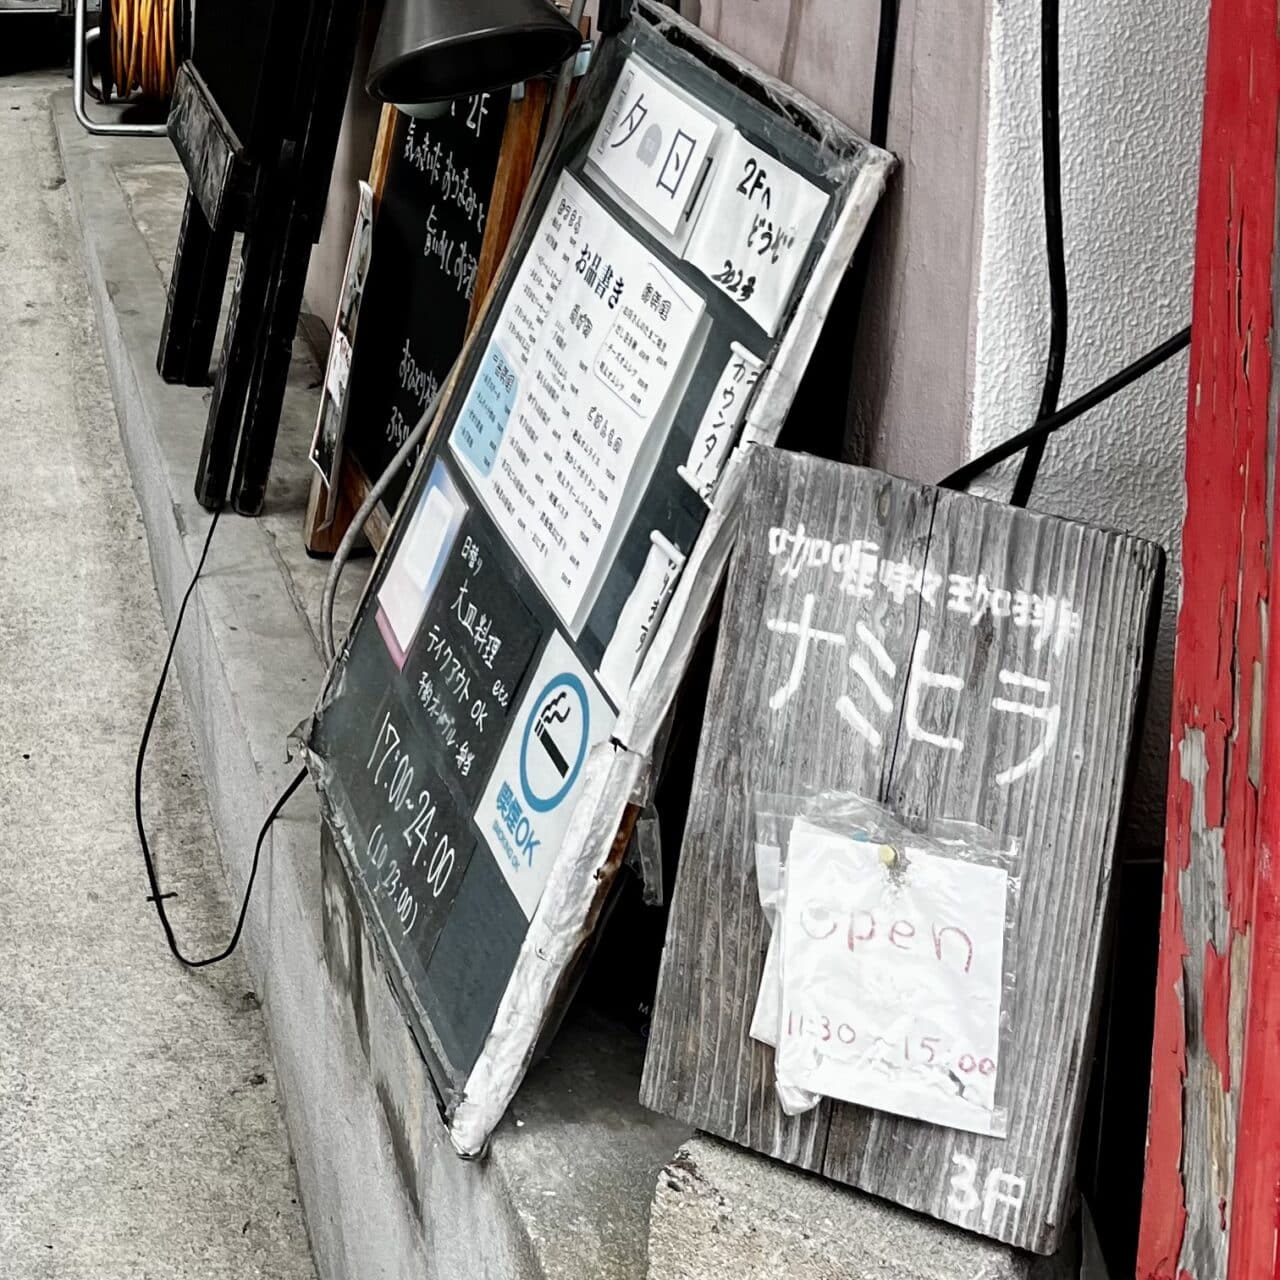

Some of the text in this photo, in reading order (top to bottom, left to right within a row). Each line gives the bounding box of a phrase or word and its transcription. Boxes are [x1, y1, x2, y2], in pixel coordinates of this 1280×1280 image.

[576, 244, 624, 309] お品書き
[748, 213, 795, 265] どうぞ
[696, 361, 745, 481] カウンター
[450, 580, 502, 670] 大皿料理
[427, 625, 488, 733] テイクアウト OK
[767, 593, 1060, 785] ナミヒラ
[496, 780, 542, 868] 喫煙OK
